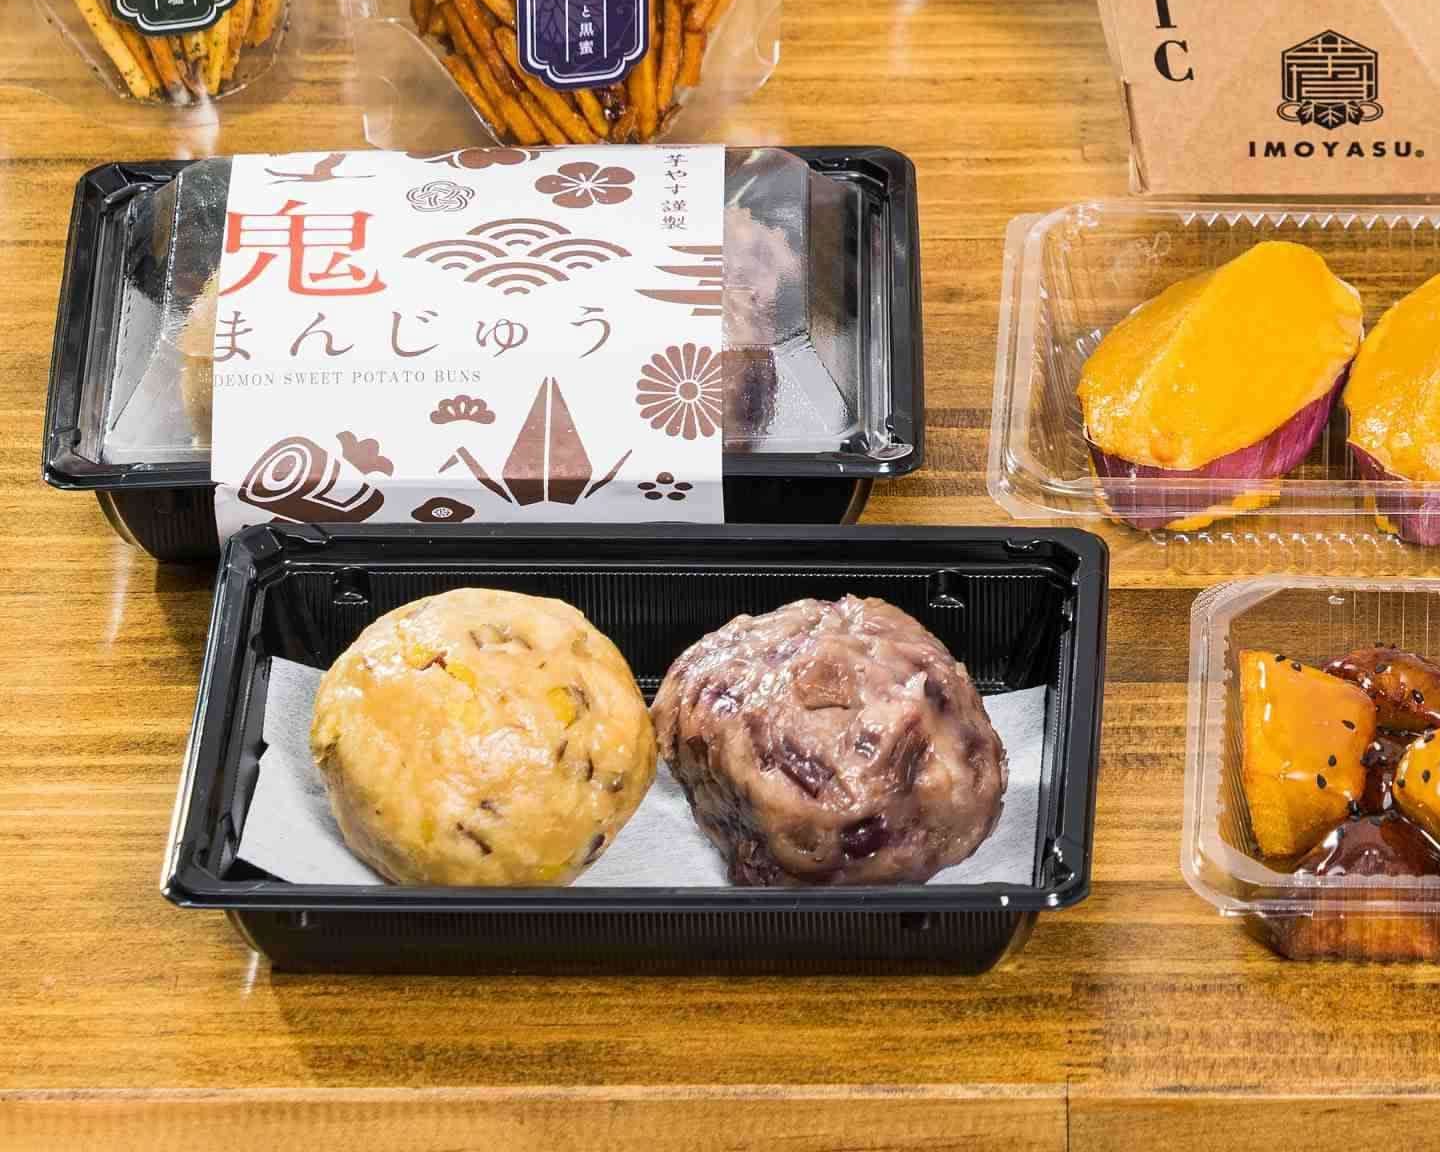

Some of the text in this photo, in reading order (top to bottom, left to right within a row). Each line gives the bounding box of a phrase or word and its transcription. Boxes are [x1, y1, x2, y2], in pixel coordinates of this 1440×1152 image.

[219, 199, 387, 297] 鬼
[214, 306, 611, 362] まんじゅう
[284, 371, 343, 385] SWEET
[352, 369, 425, 383] POTATO
[435, 369, 481, 382] BUNS
